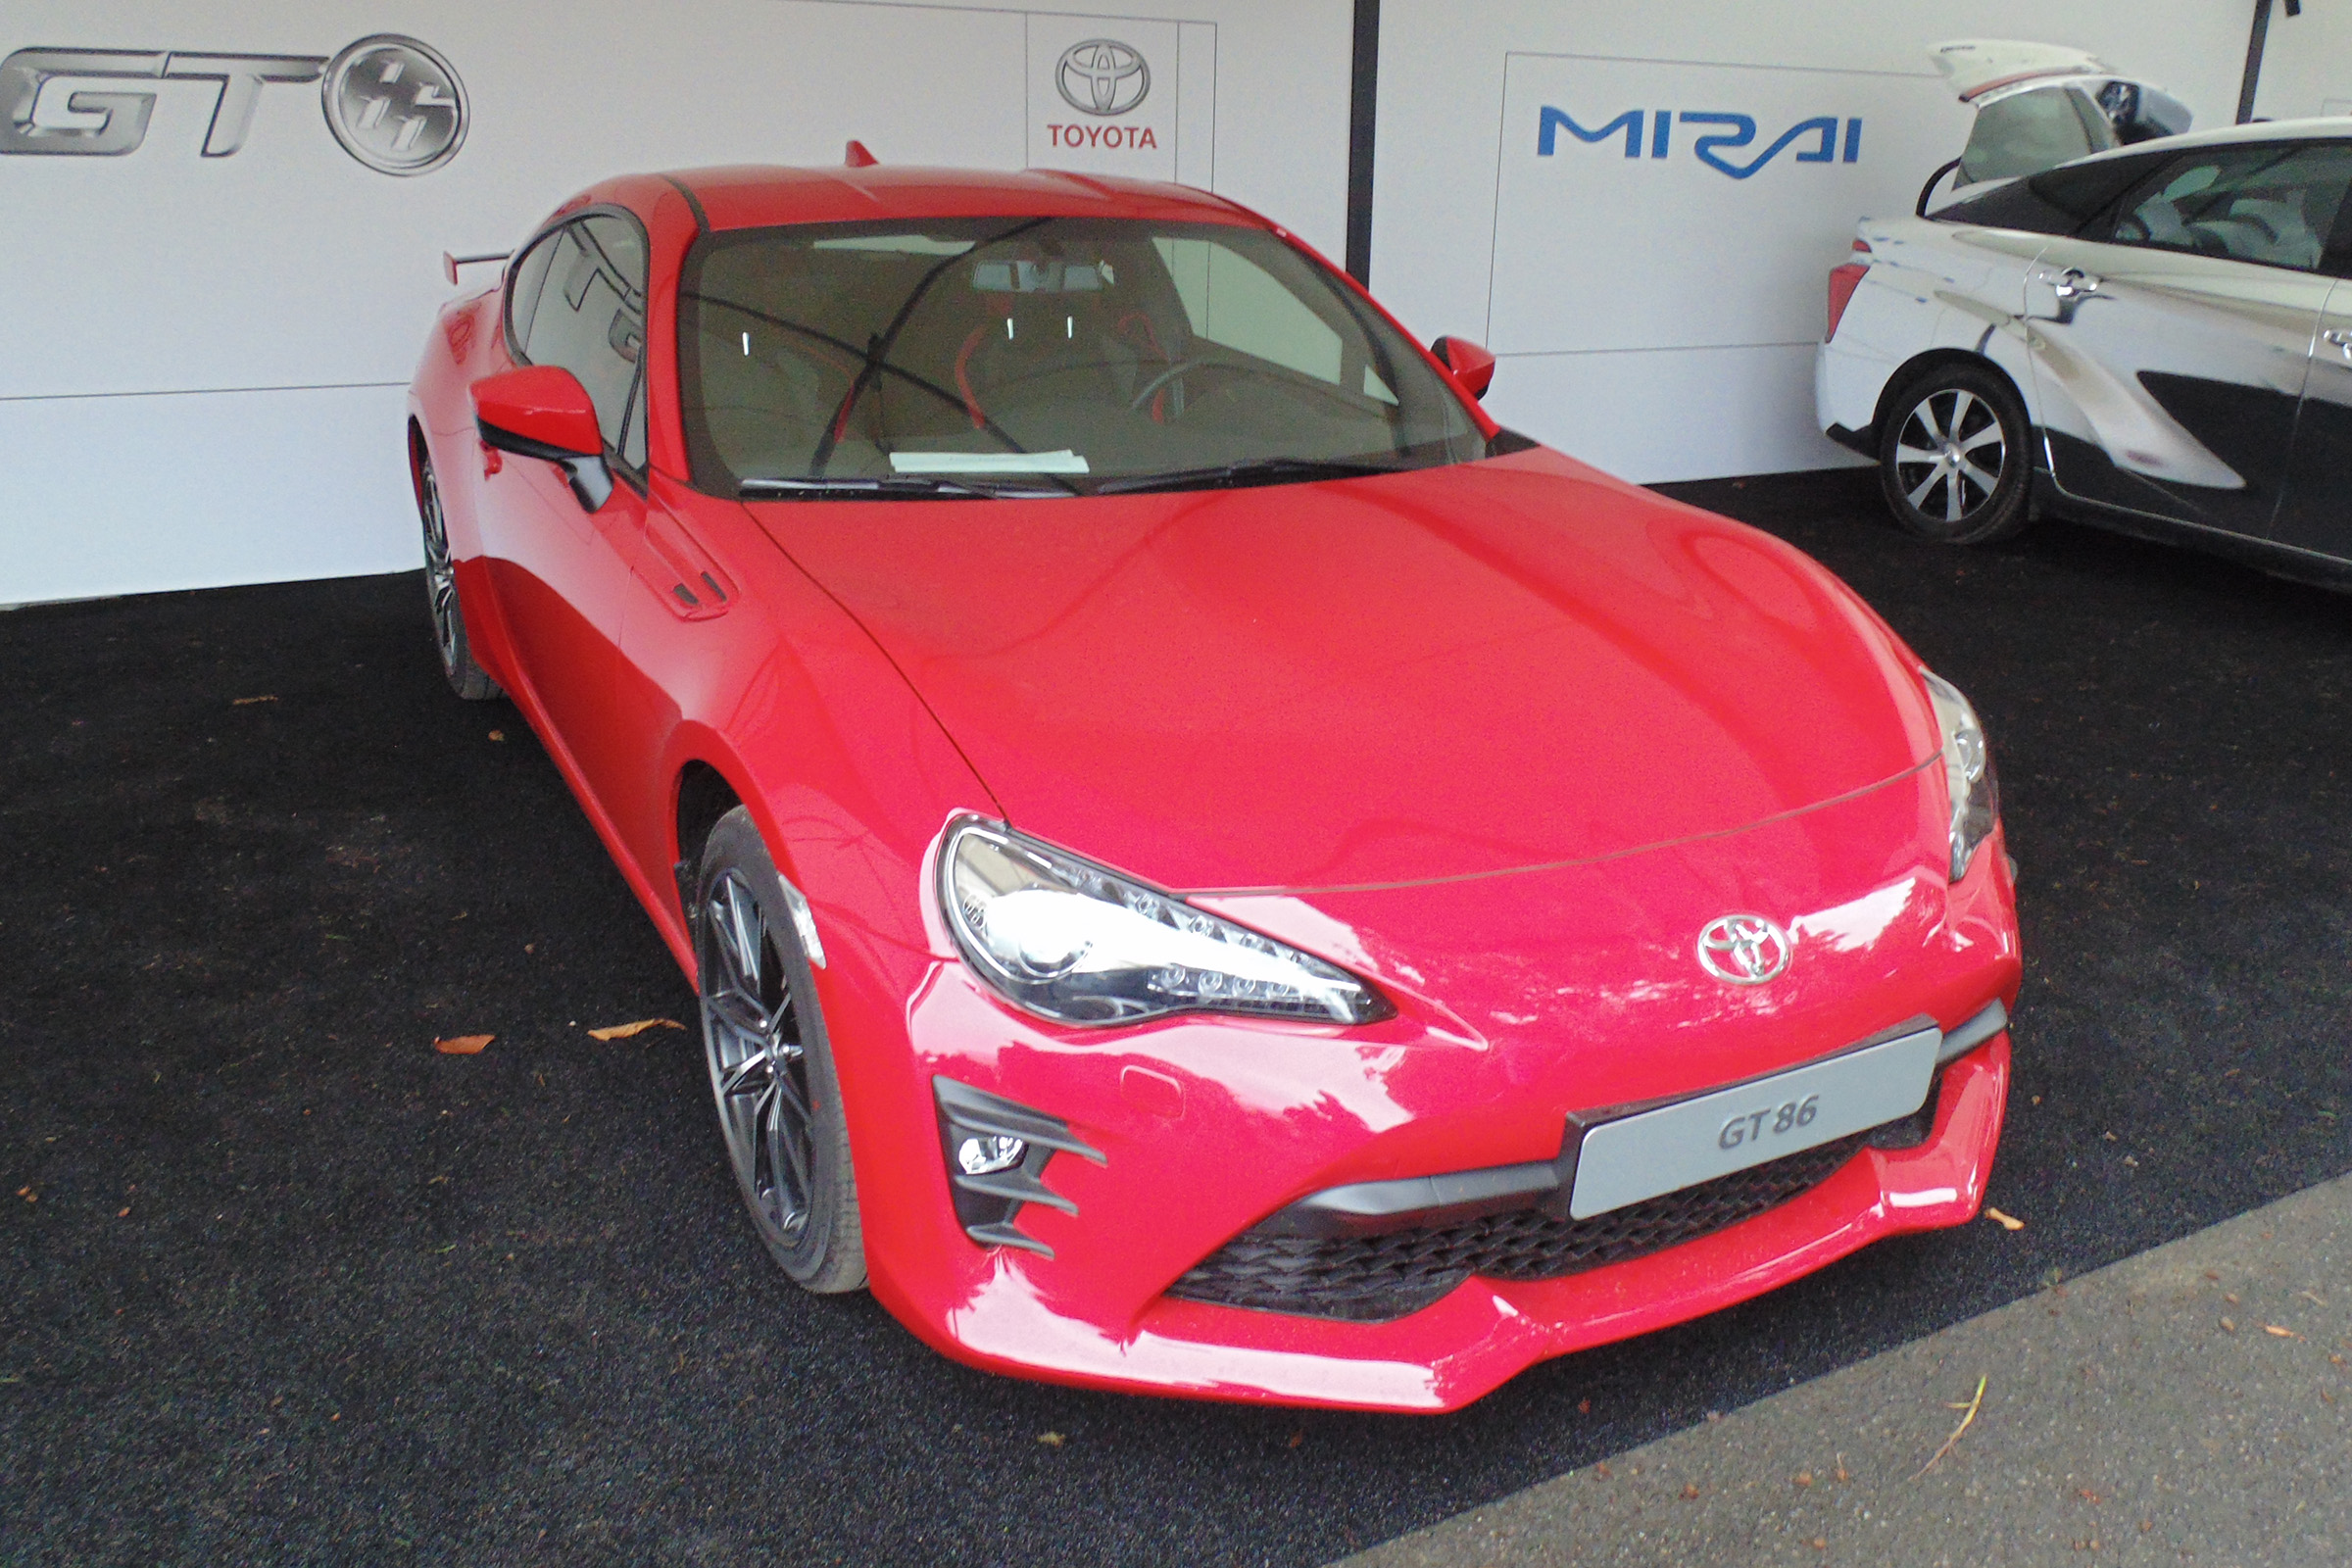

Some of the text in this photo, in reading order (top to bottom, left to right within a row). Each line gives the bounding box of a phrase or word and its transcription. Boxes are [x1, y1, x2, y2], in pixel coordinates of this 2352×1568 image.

[1046, 124, 1156, 149] TOYOTA
[1537, 105, 1862, 179] MIRAI
[1718, 1095, 1819, 1150] GT 86
